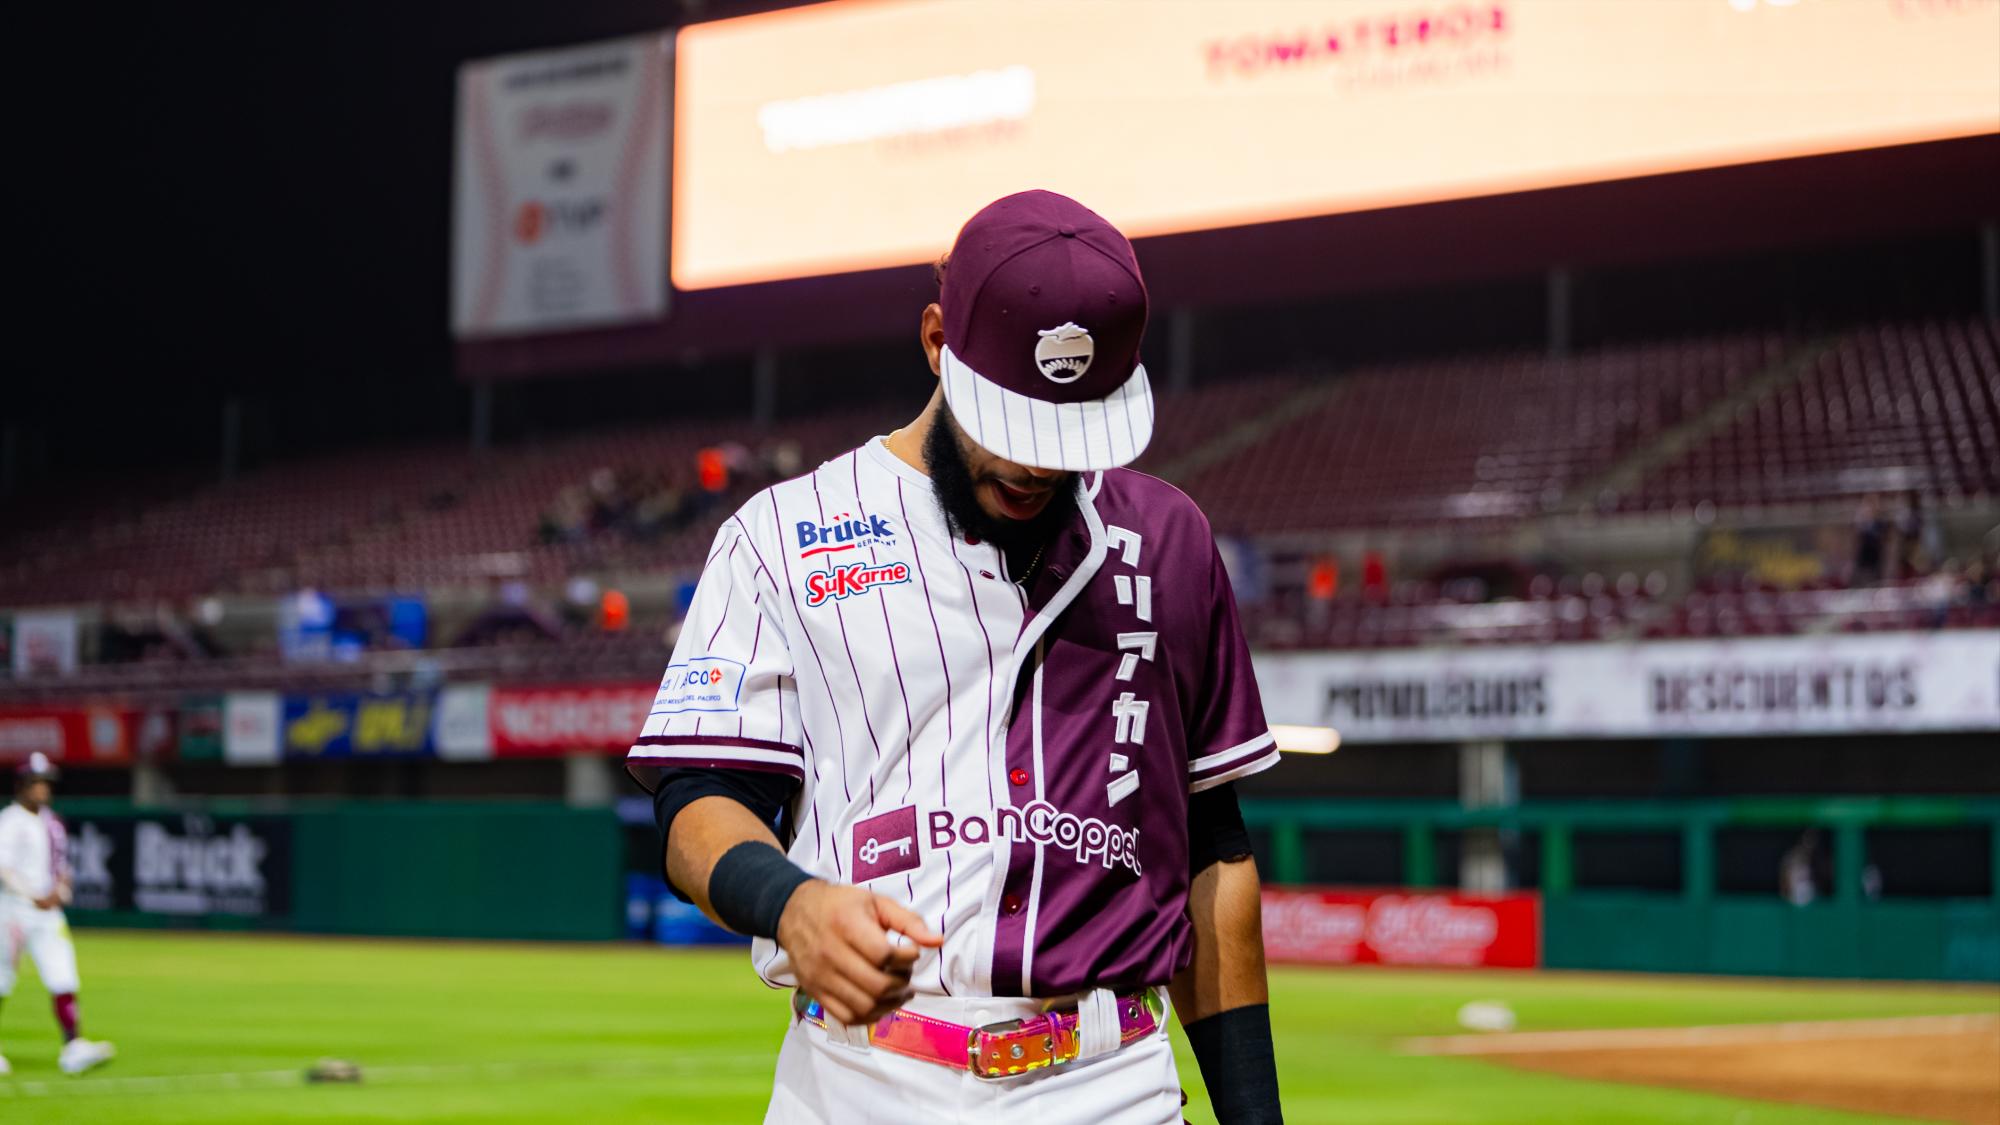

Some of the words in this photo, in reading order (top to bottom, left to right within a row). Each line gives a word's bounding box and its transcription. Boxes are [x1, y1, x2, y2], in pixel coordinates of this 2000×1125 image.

[796, 512, 895, 548] Brück
[806, 562, 910, 607] SuKarne
[1650, 664, 1919, 713] DESCUENTOS
[928, 801, 1142, 877] BanCoppel
